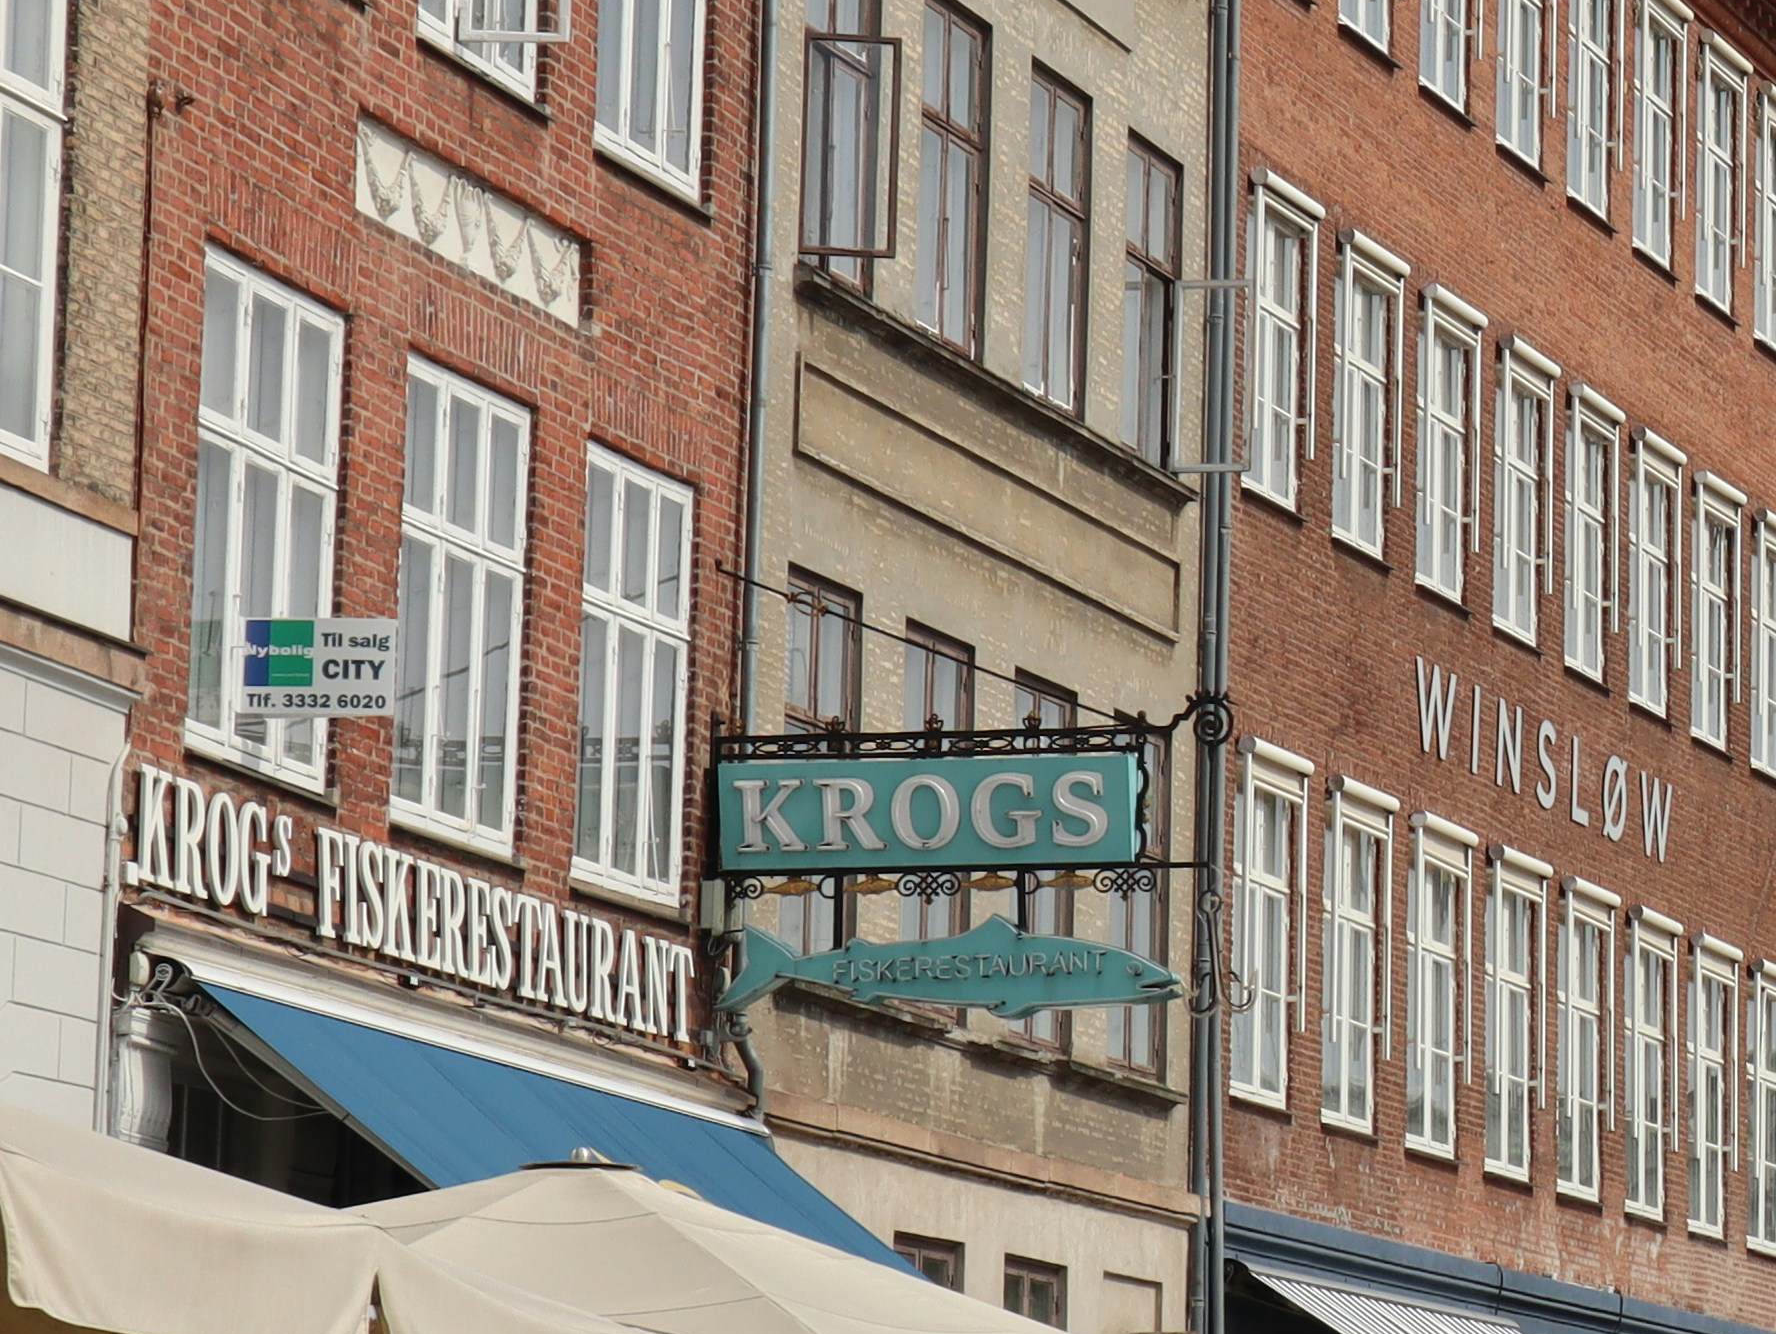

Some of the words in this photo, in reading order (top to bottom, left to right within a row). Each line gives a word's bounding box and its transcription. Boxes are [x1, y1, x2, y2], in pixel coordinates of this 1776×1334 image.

[242, 641, 314, 659] Nybolig
[321, 632, 343, 647] Til
[348, 633, 391, 652] salg
[321, 658, 386, 681] CITY
[246, 693, 277, 708] Tlf.
[282, 693, 331, 708] 3332
[337, 694, 387, 709] 6020
[1414, 655, 1674, 864] WINSLØW
[732, 770, 1110, 854] KROGS
[315, 826, 697, 1044] FISKERESTAURANT
[831, 950, 1108, 982] FISKERESTAURANT
